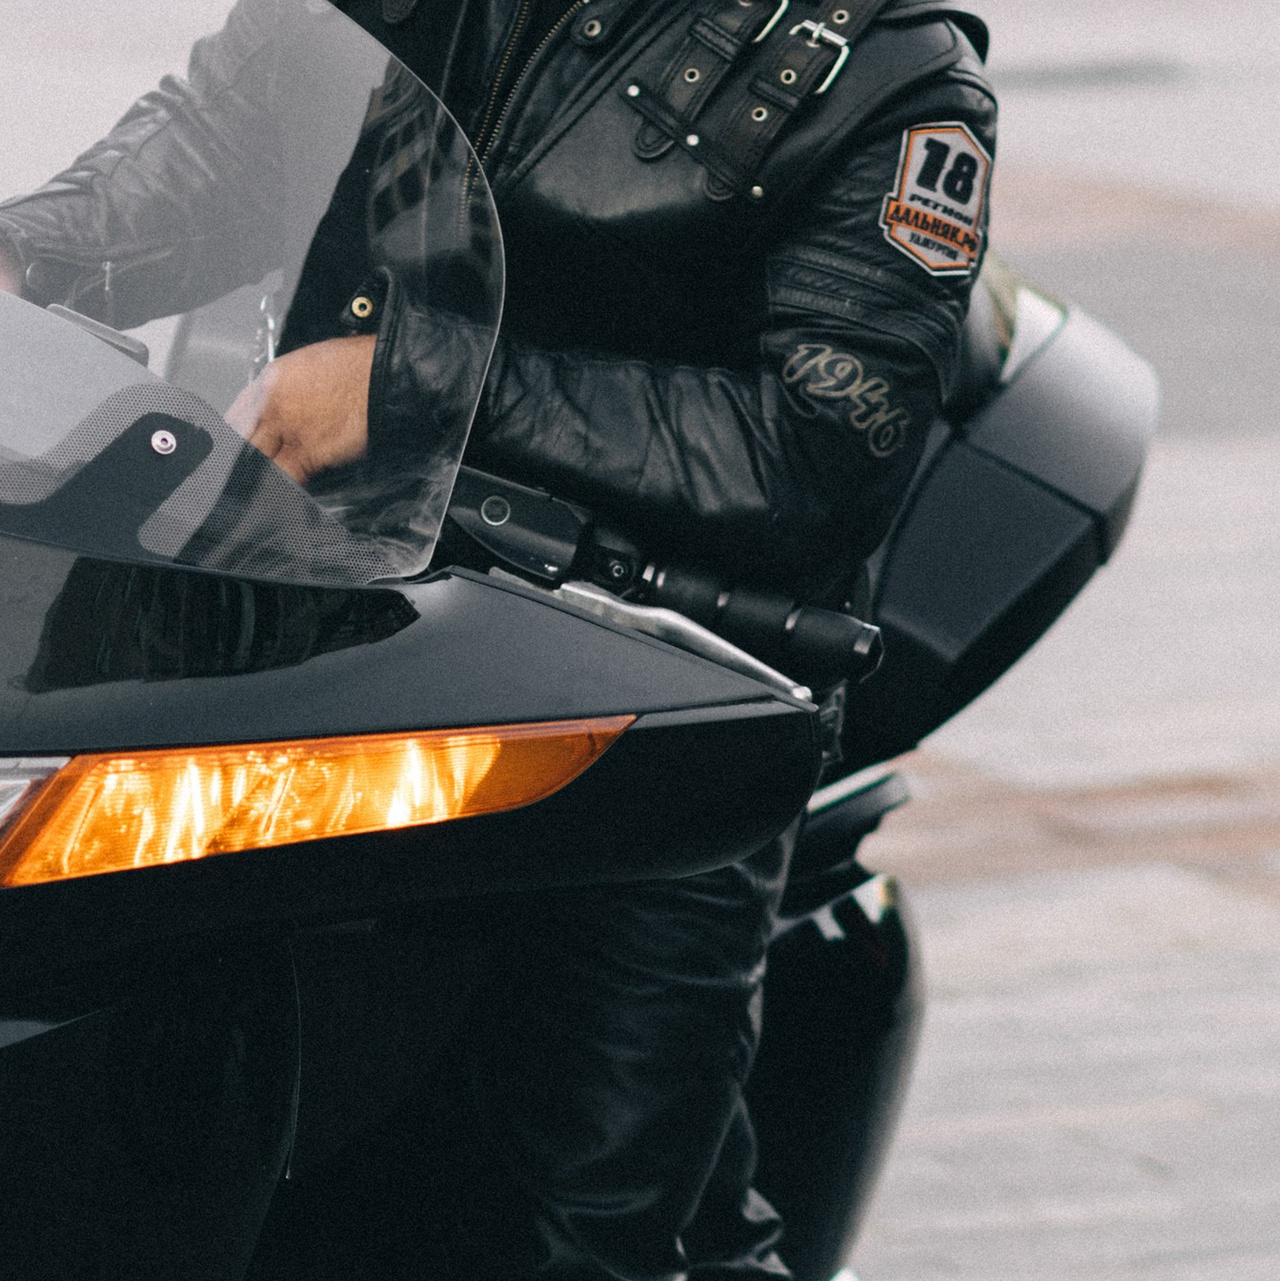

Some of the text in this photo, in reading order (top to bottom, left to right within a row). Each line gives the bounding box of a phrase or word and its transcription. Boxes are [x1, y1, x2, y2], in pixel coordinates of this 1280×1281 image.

[915, 137, 979, 206] 18
[908, 193, 973, 226] РЕГИОН
[782, 343, 911, 459] 1946
